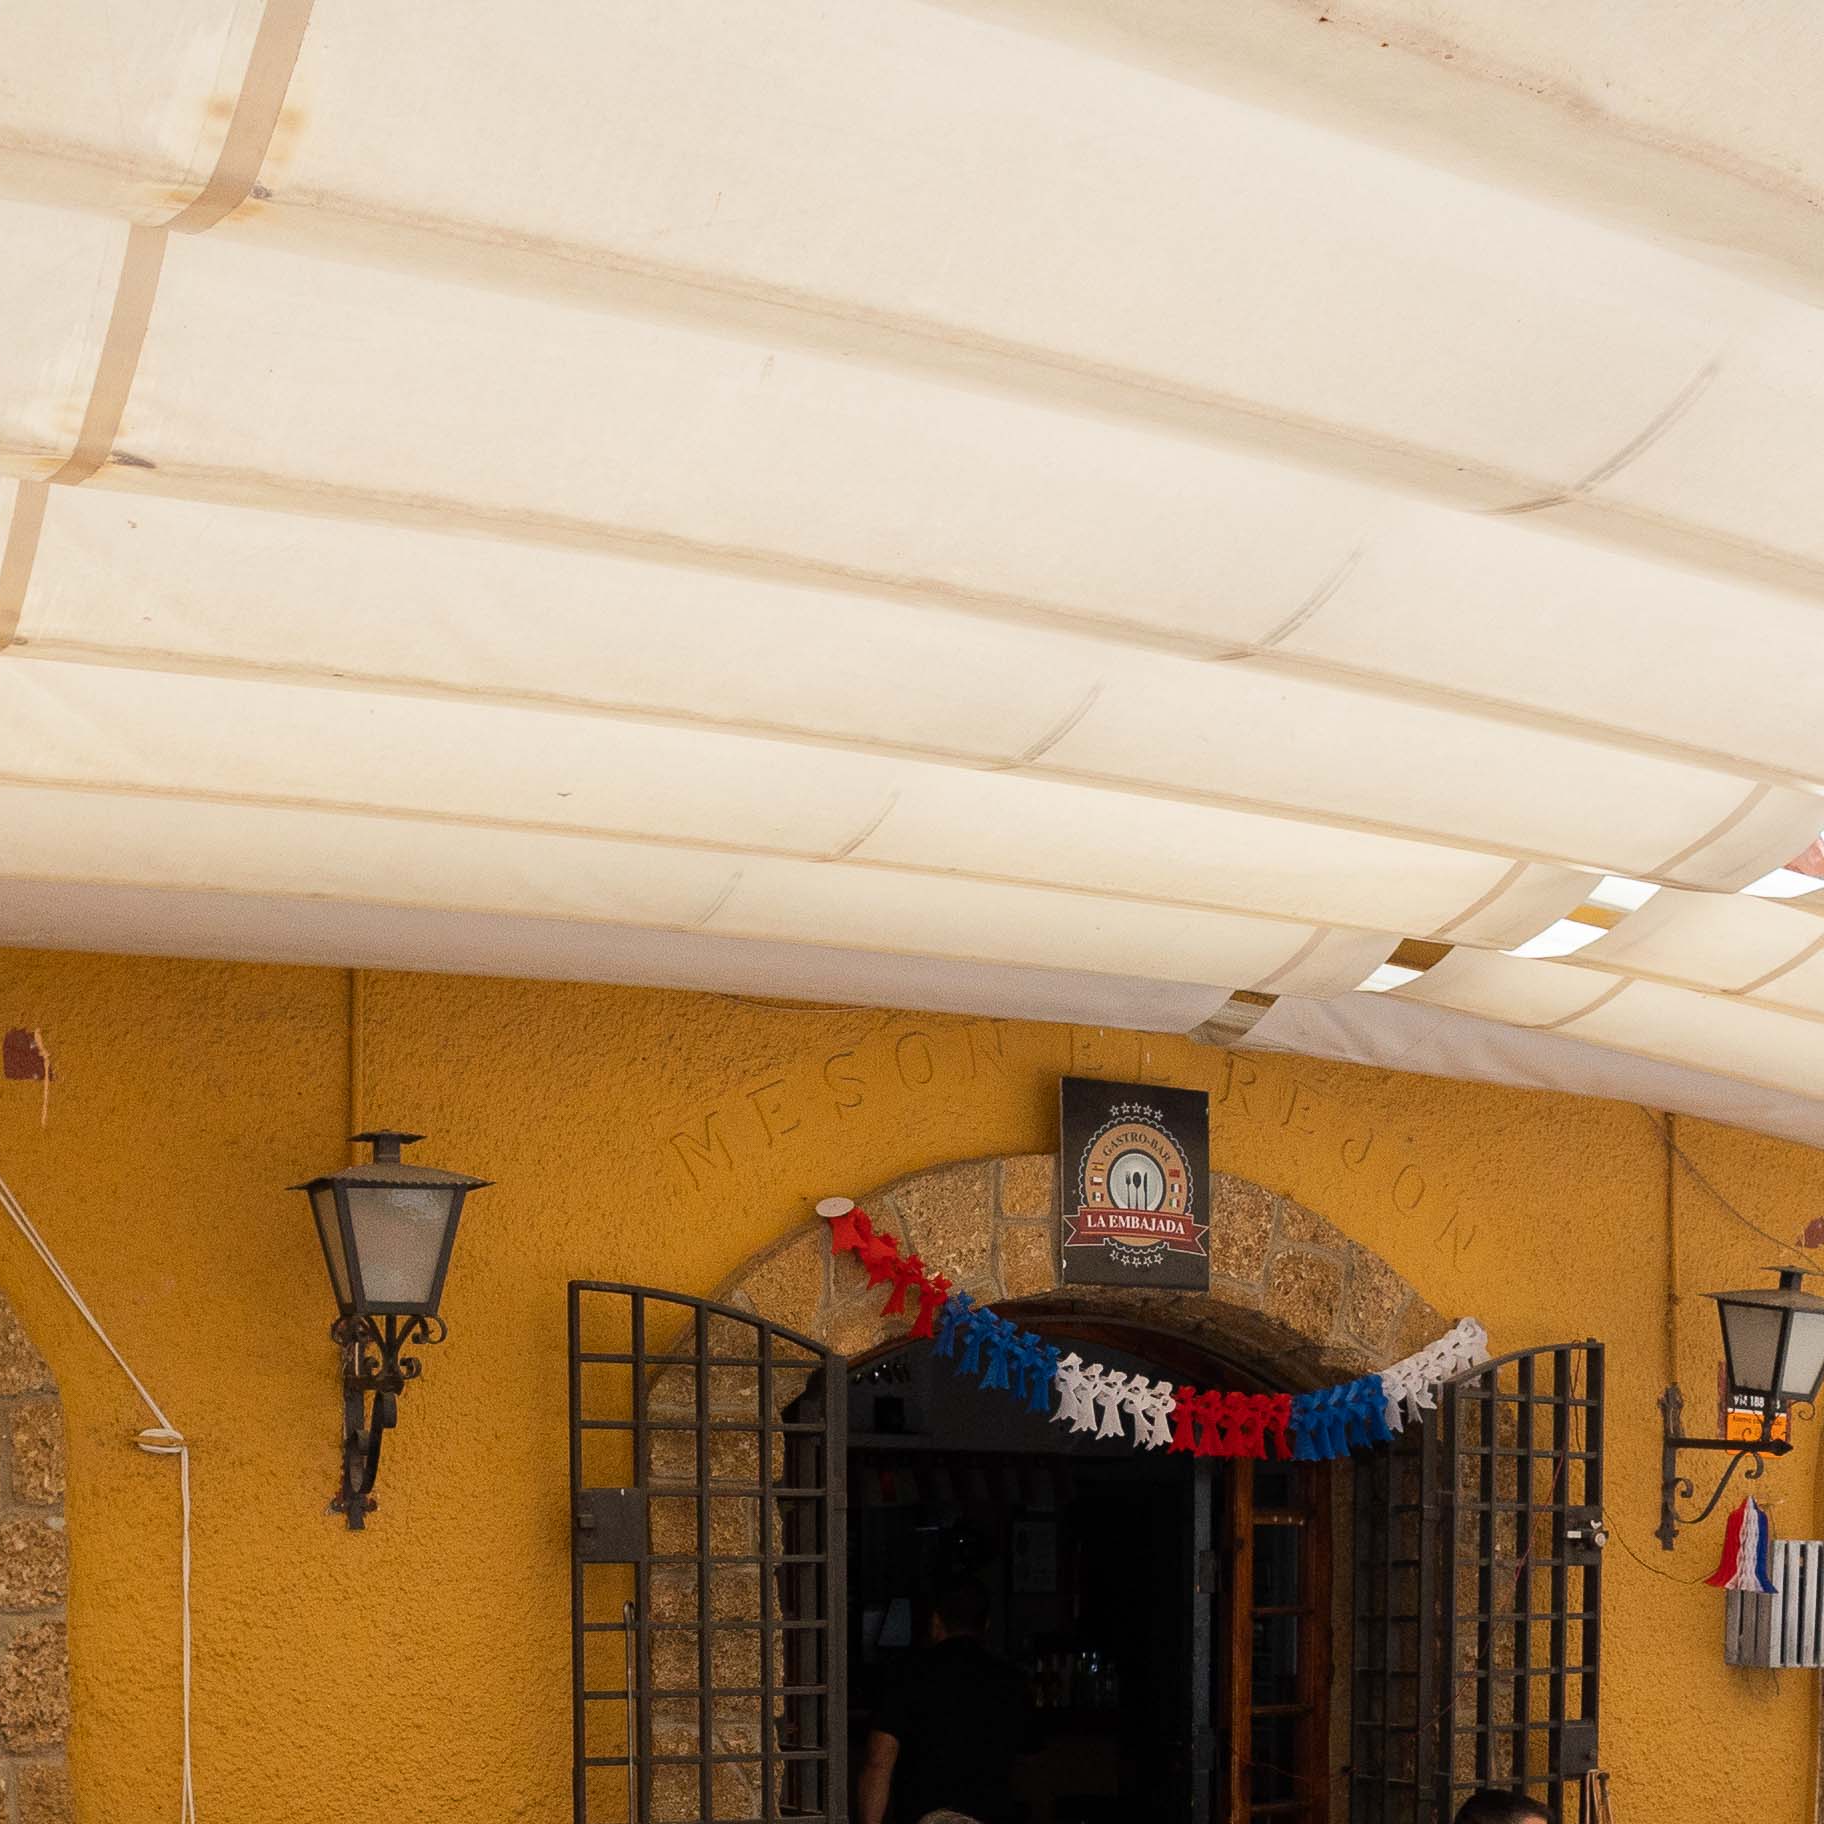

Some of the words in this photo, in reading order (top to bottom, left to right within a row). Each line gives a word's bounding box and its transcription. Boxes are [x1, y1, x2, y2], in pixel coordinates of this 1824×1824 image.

[1102, 1131, 1172, 1164] GASTRO-BAR
[1086, 1214, 1107, 1228] LA
[1108, 1215, 1185, 1235] EMBAJADA
